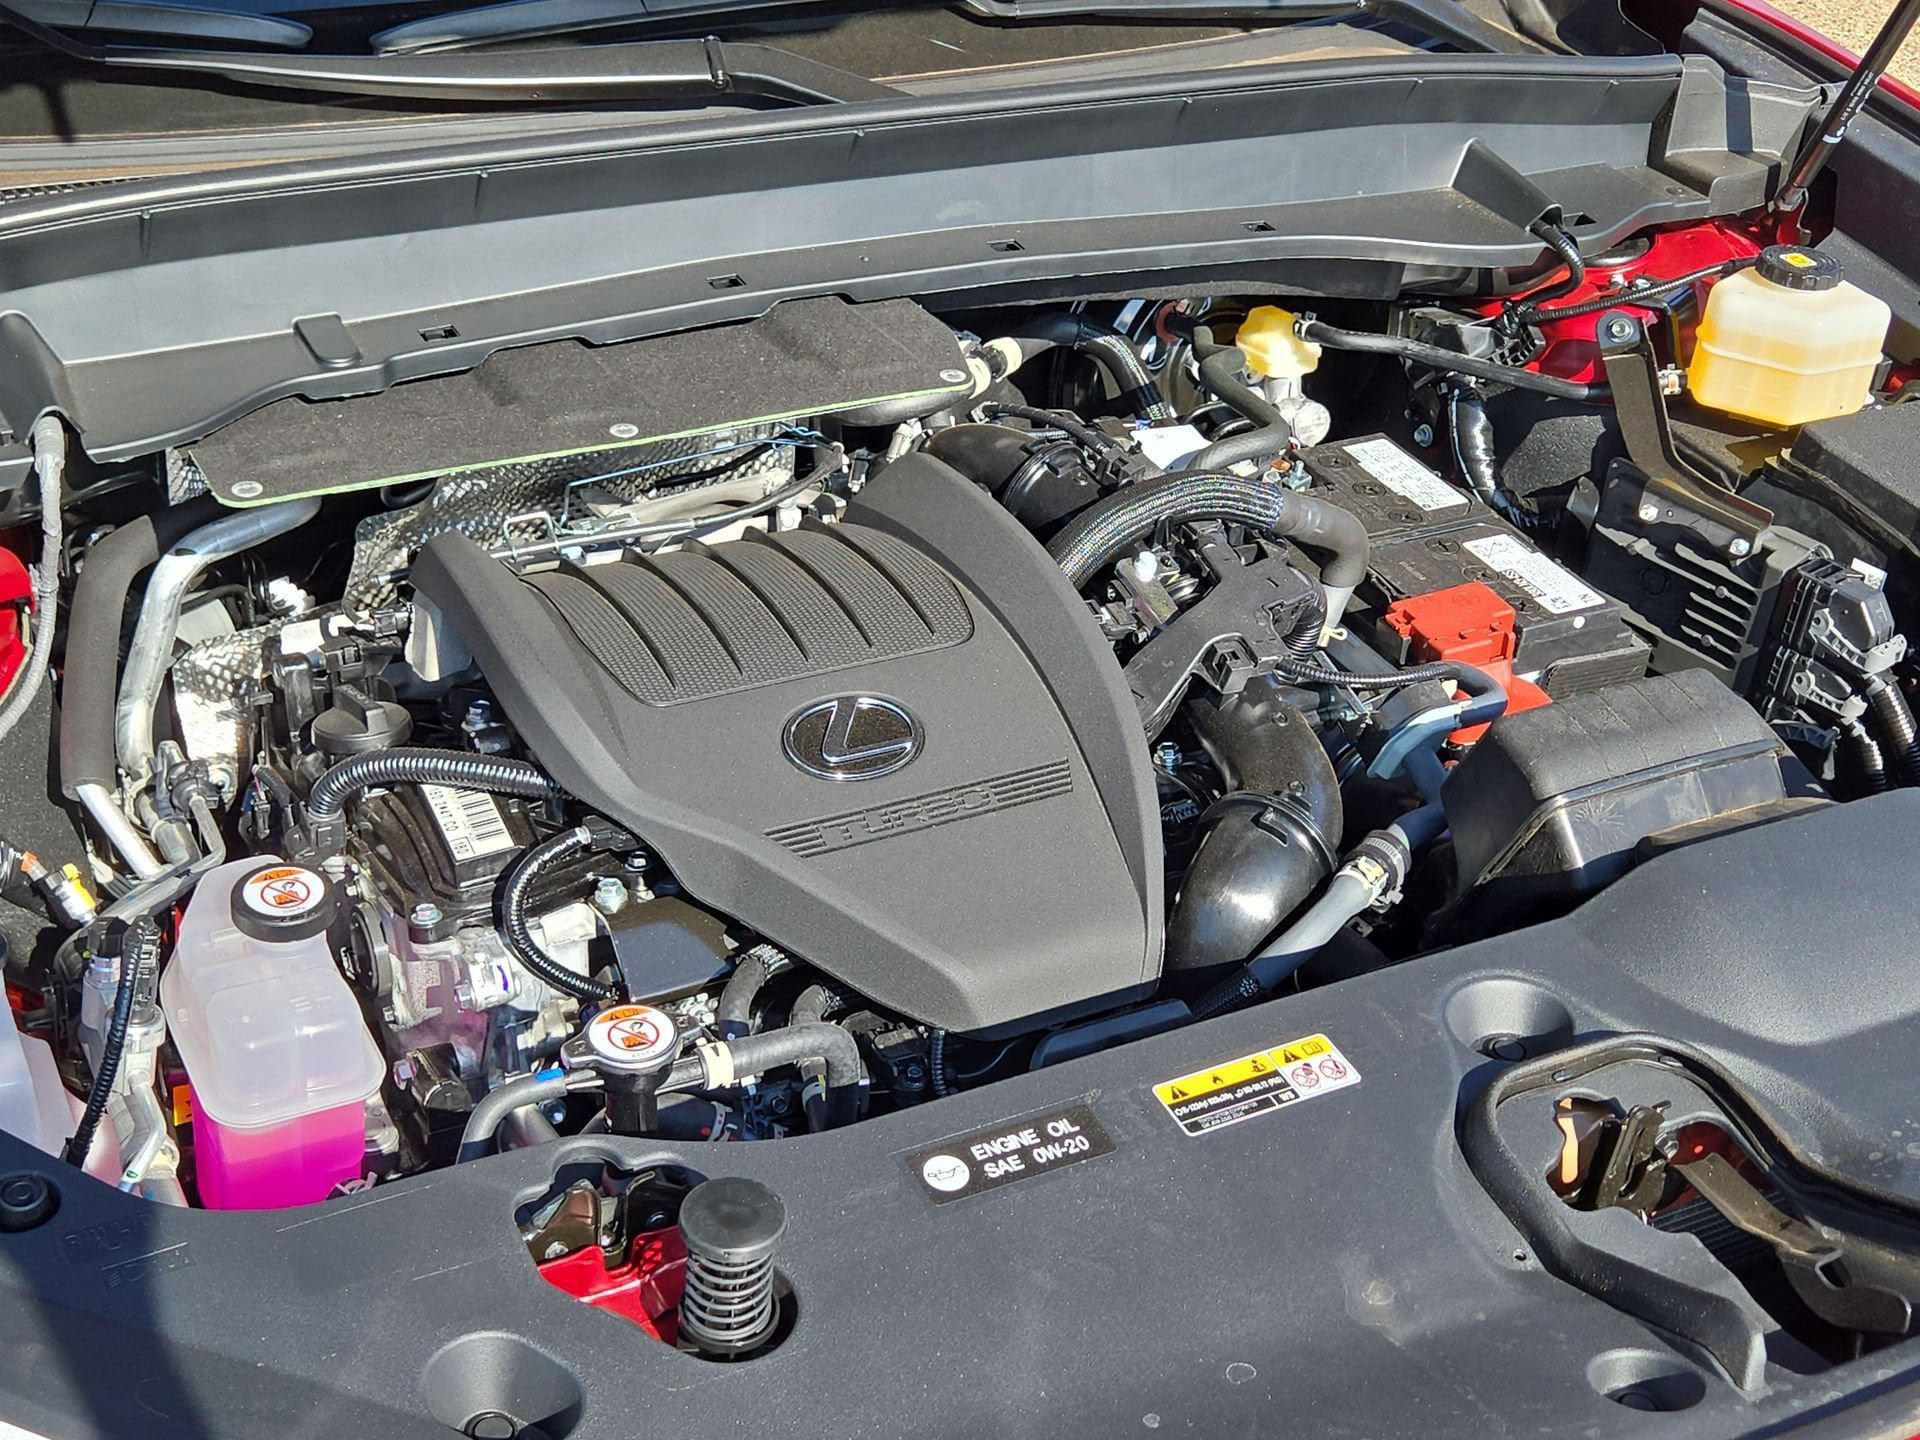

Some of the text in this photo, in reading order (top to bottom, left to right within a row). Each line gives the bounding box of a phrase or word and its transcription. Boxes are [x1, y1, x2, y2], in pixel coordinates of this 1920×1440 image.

[819, 788, 992, 847] TURBO
[970, 1118, 1080, 1161] ENGINE OIL
[983, 1135, 1090, 1179] SAE 0W-20
